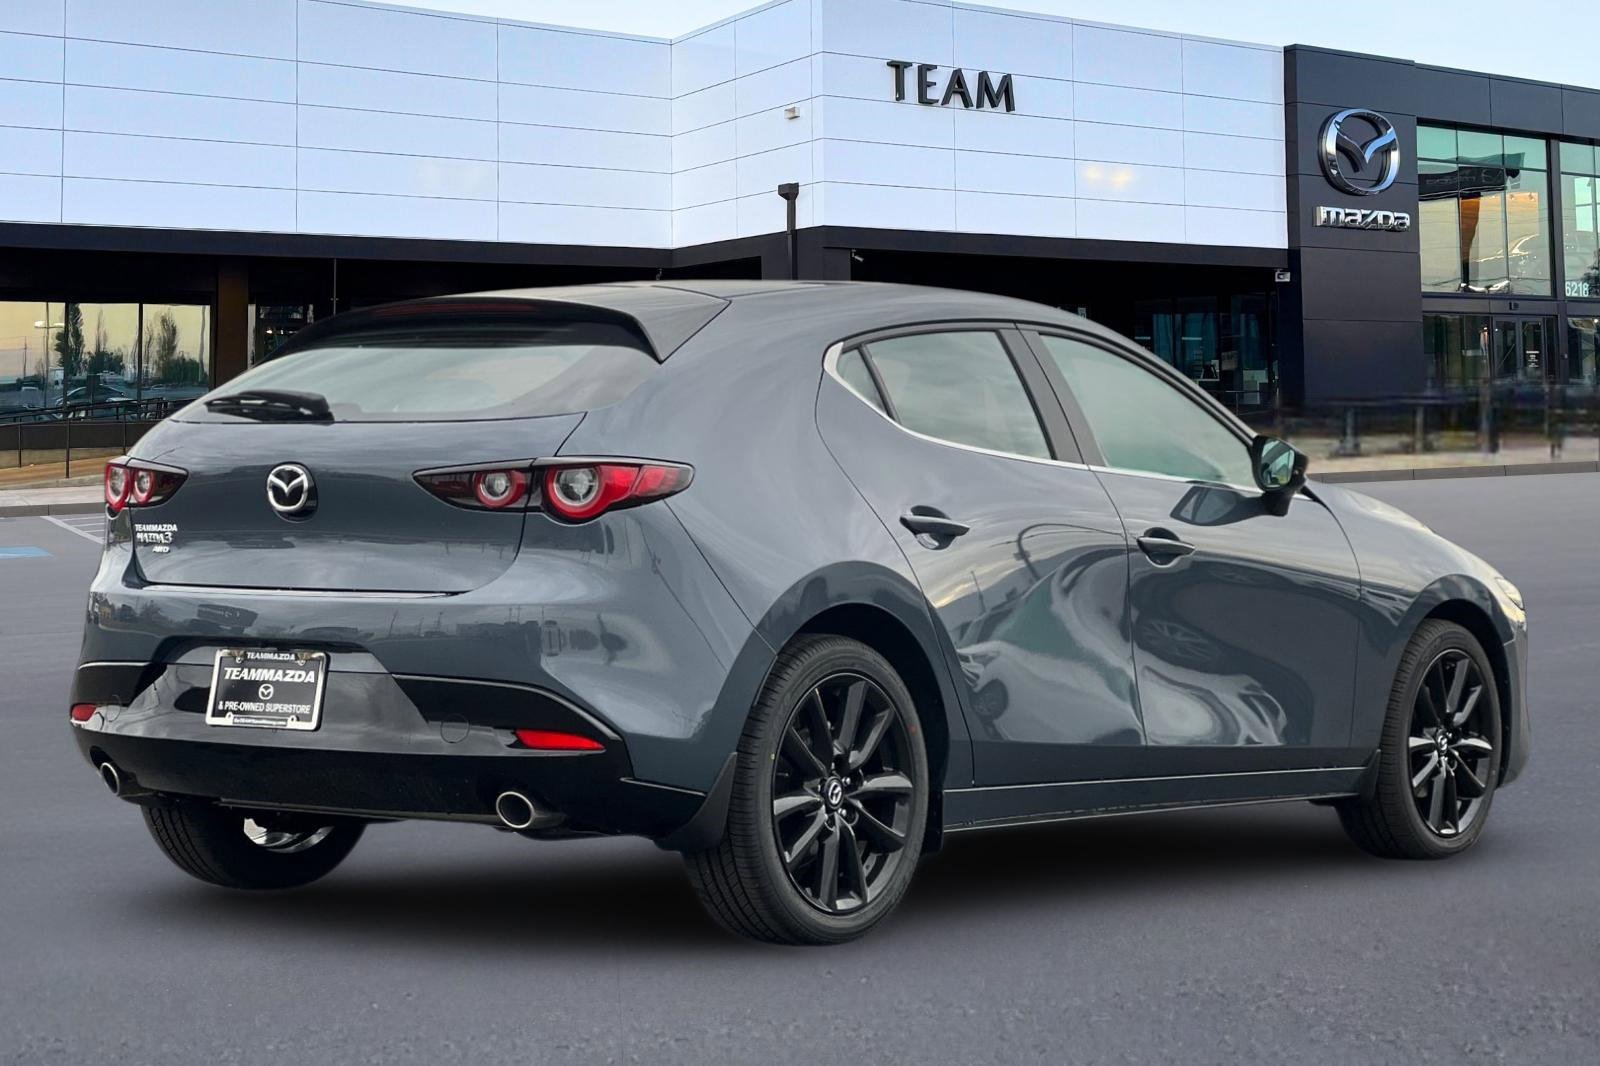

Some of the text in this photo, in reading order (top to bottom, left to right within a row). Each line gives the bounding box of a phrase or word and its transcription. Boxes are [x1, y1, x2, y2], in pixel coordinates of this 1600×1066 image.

[887, 60, 1015, 112] TEAM
[1313, 206, 1410, 232] mazda
[1565, 281, 1589, 297] 6218
[134, 523, 178, 532] TEAMMAZDA
[246, 652, 296, 661] TEAMMAZDA
[223, 667, 315, 683] TEAMMAZDA
[224, 701, 265, 712] PRE-OWNED
[265, 703, 312, 714] SUPERSTORE
